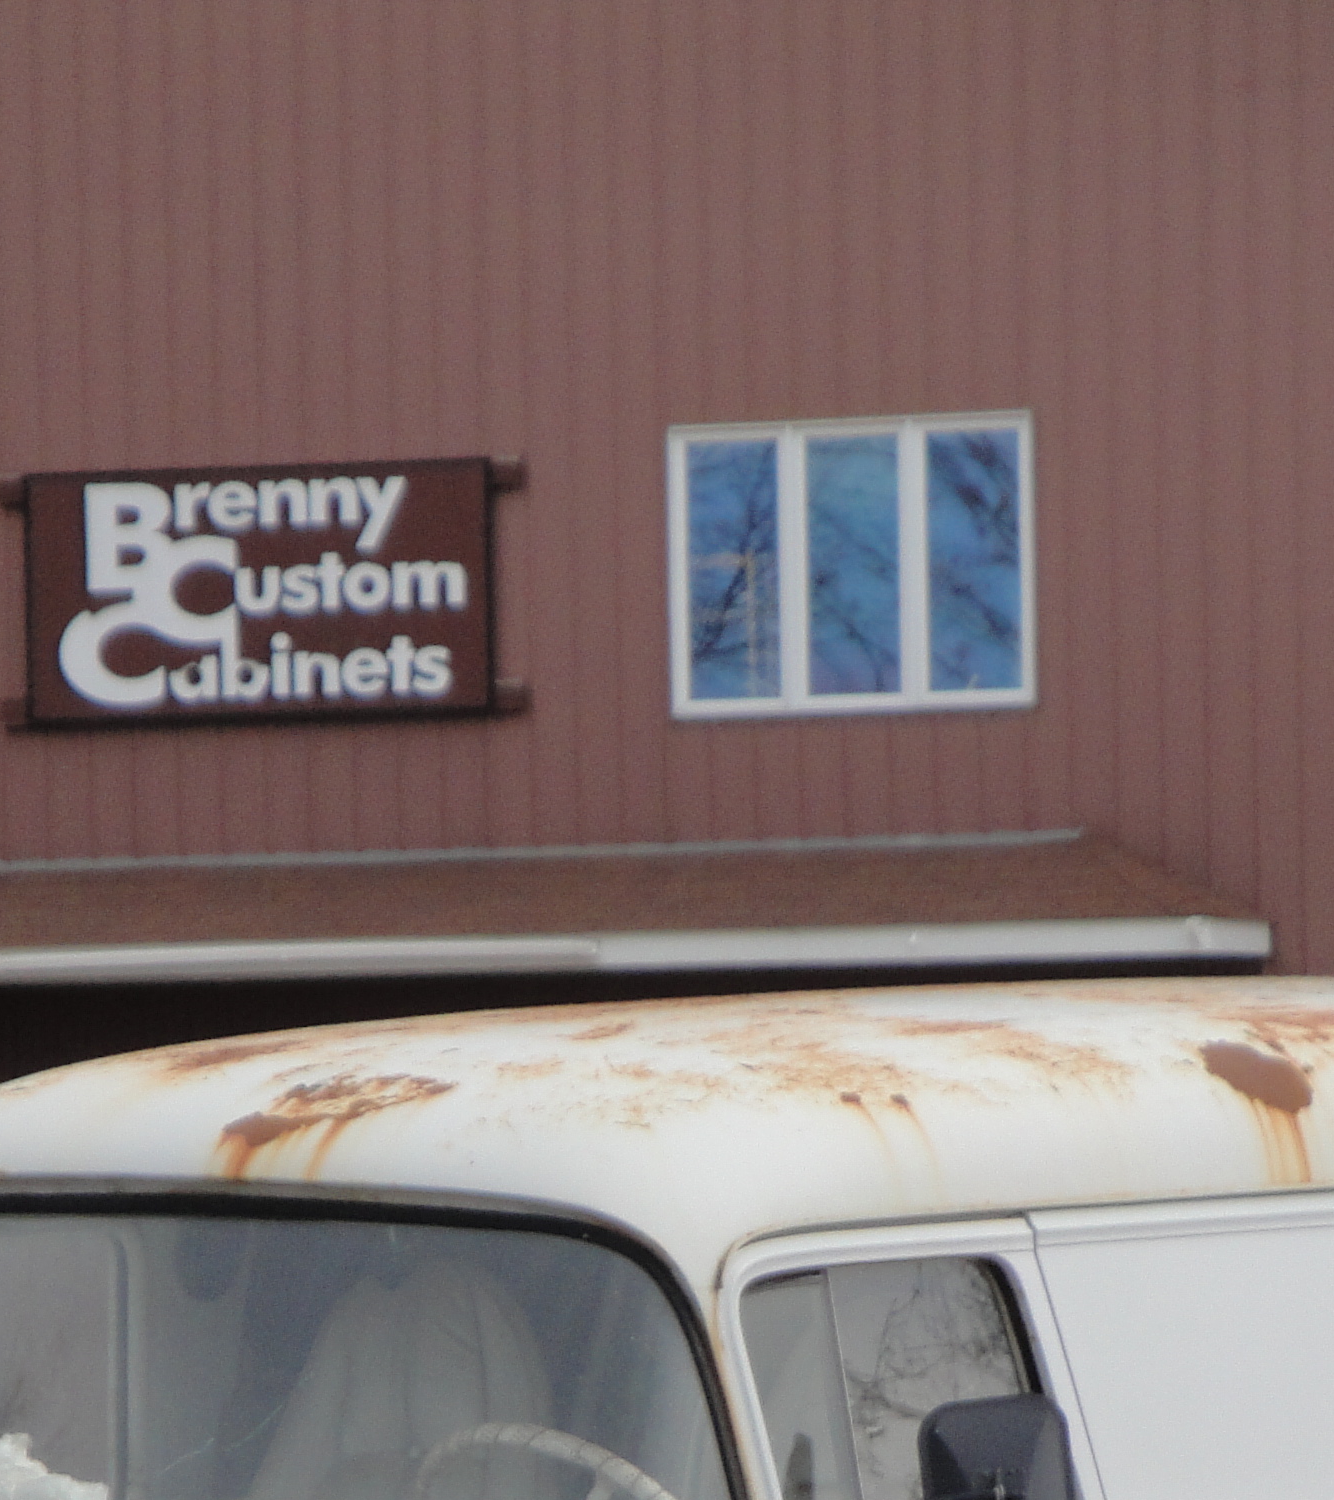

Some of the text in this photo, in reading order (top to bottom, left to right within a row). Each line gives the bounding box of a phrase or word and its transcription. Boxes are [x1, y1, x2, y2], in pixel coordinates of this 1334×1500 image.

[83, 475, 407, 596] Brenny
[135, 534, 467, 647] Custom
[59, 599, 453, 711] Cabinets
